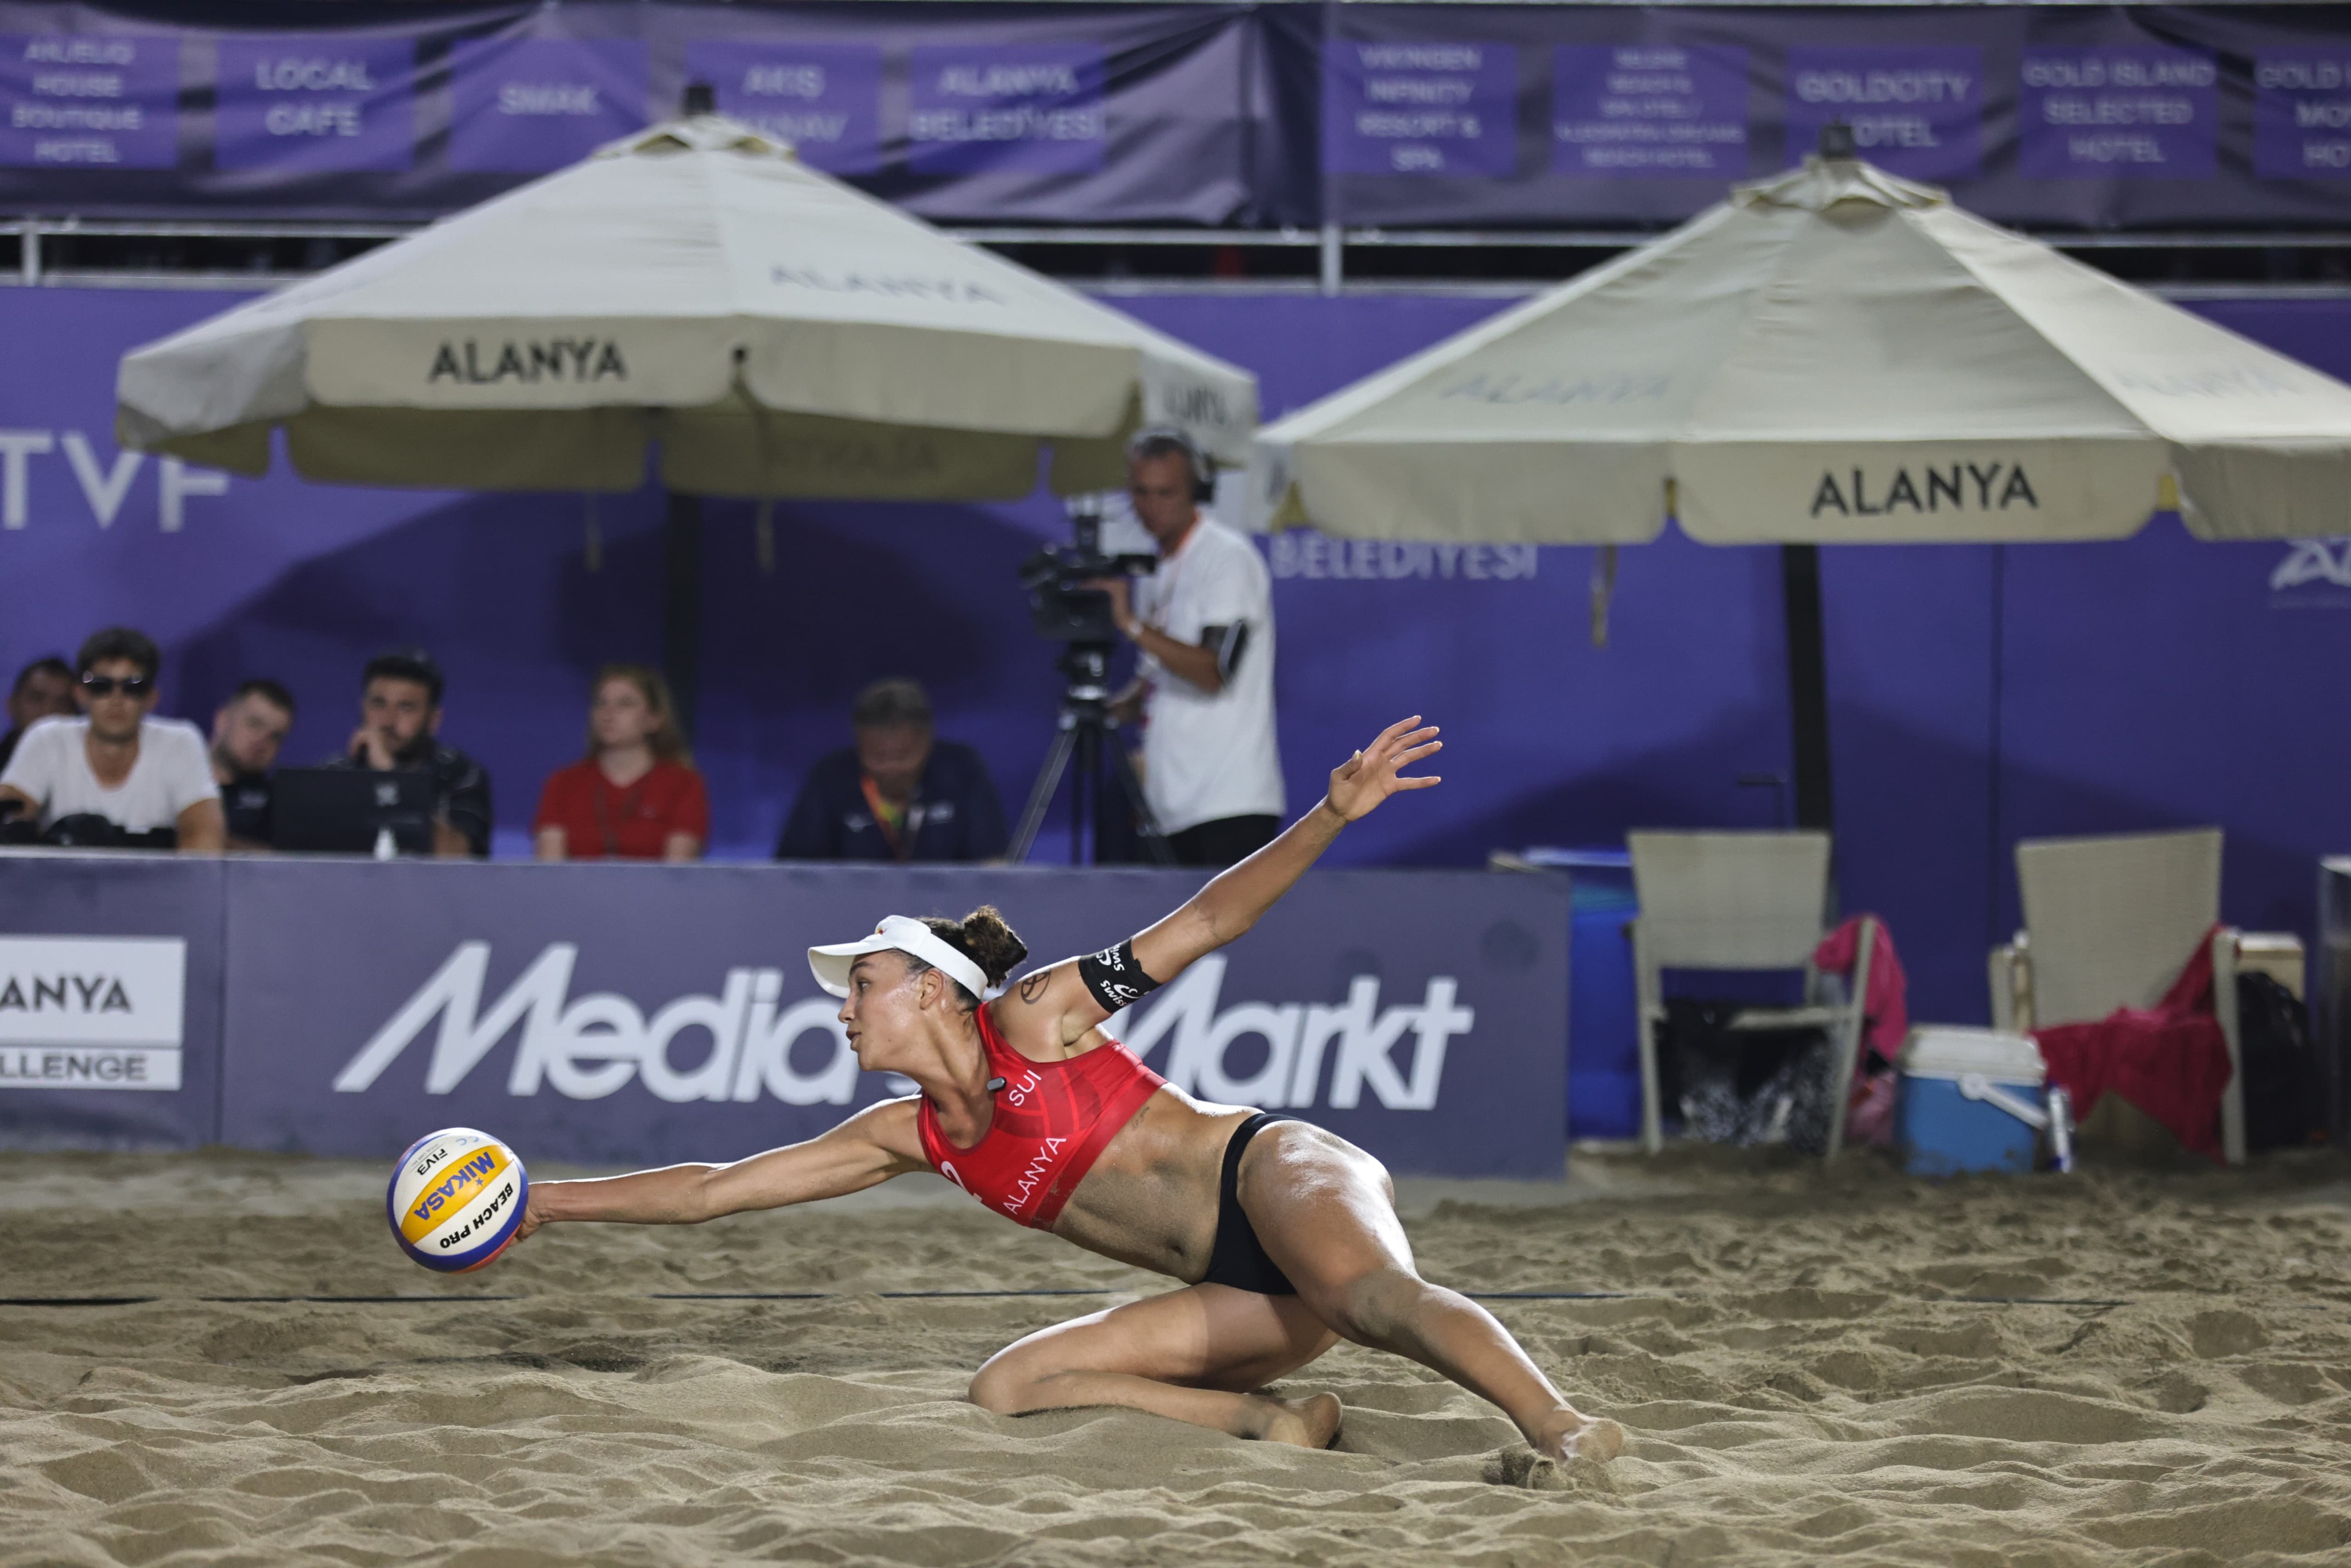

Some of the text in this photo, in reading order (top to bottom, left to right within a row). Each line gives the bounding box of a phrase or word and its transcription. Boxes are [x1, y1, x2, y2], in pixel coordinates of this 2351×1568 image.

[254, 59, 376, 91] LOCAL
[936, 66, 1078, 96] ALANYA
[1796, 71, 1972, 103] GOLDCITY
[2022, 59, 2217, 87] GOLD ISLAND
[2256, 62, 2341, 90] GOLD
[265, 103, 360, 136] CAFE
[2042, 96, 2194, 126] SELECTED
[1852, 119, 1938, 148] OTEL
[2068, 135, 2166, 164] HOTEL
[428, 339, 629, 385] ALANYA
[0, 429, 228, 533] TVF
[1810, 461, 2040, 518] ALANYA
[0, 974, 134, 1014] ANYA
[334, 938, 864, 1107] Media
[1008, 1069, 1042, 1107] SUI
[417, 1148, 448, 1175] FIVB
[1003, 1136, 1067, 1215] ALANYA
[440, 1182, 514, 1249] BEACH PRO
